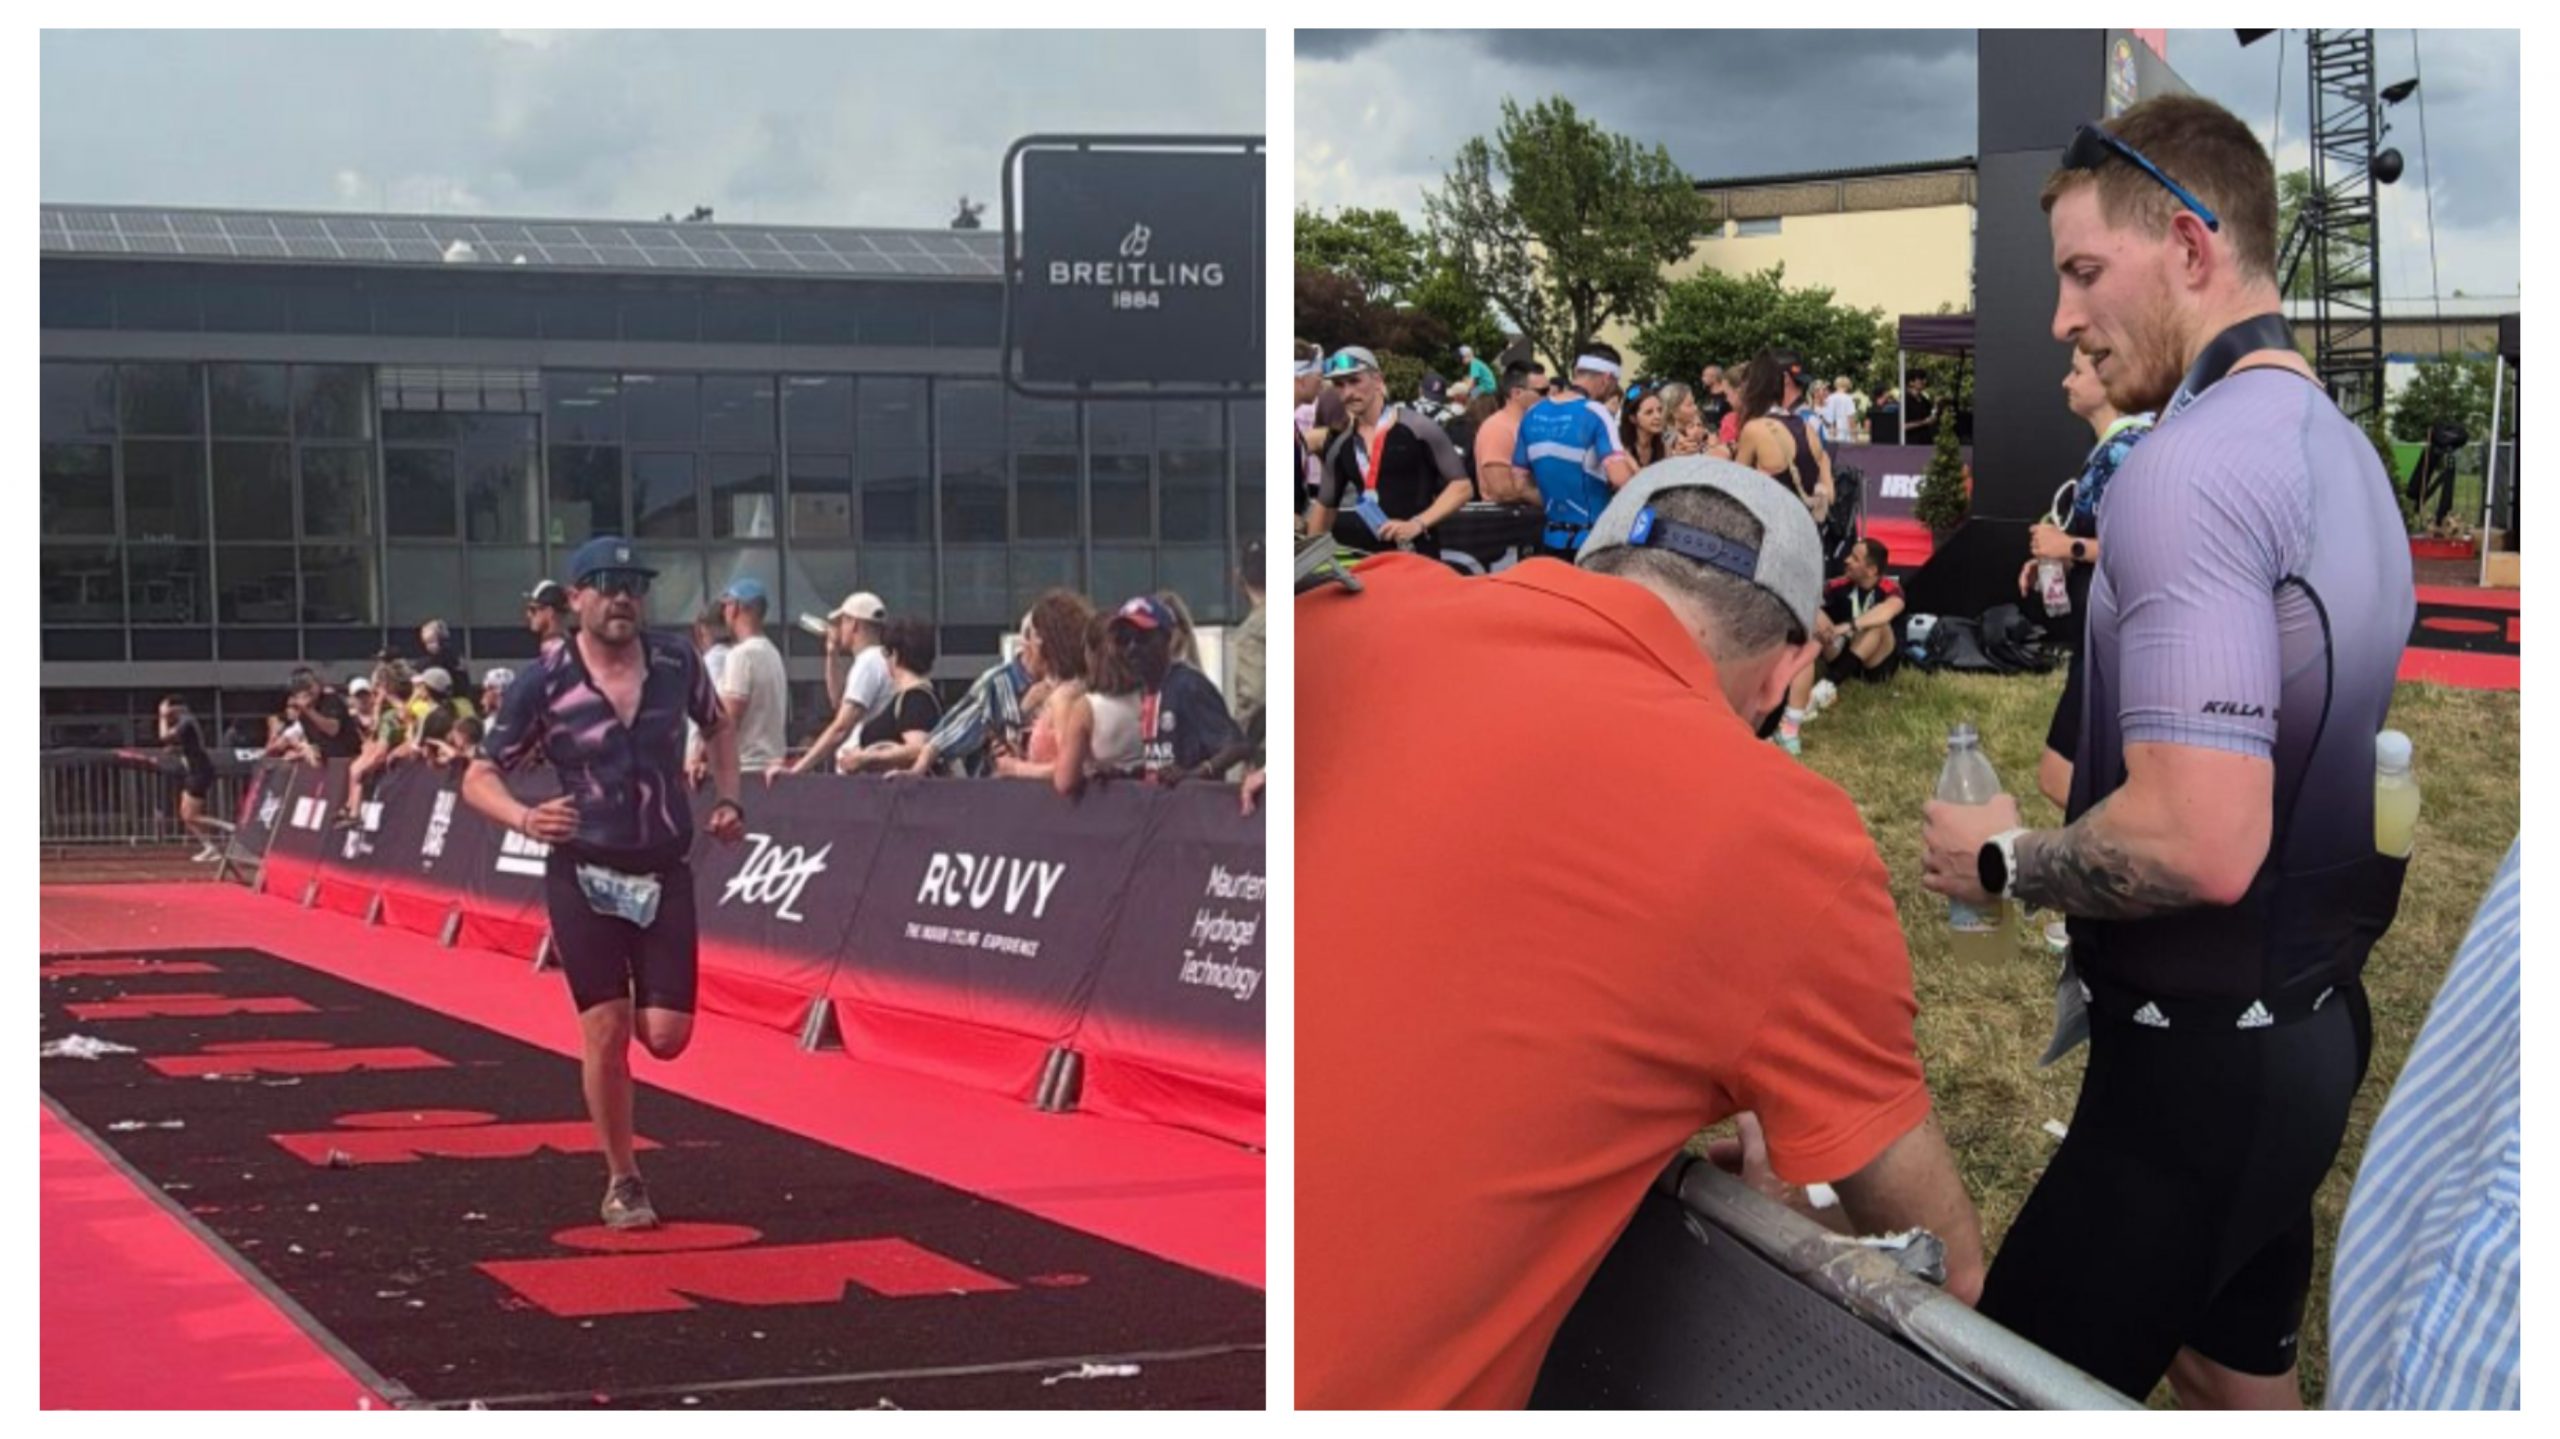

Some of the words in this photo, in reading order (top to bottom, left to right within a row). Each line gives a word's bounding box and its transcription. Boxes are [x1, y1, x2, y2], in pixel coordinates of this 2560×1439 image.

[1050, 262, 1224, 286] BREITLING
[1112, 290, 1160, 309] 1884
[917, 853, 1066, 918] ROUVY
[1190, 907, 1261, 953] Hydrogel
[1179, 949, 1263, 1001] Technology
